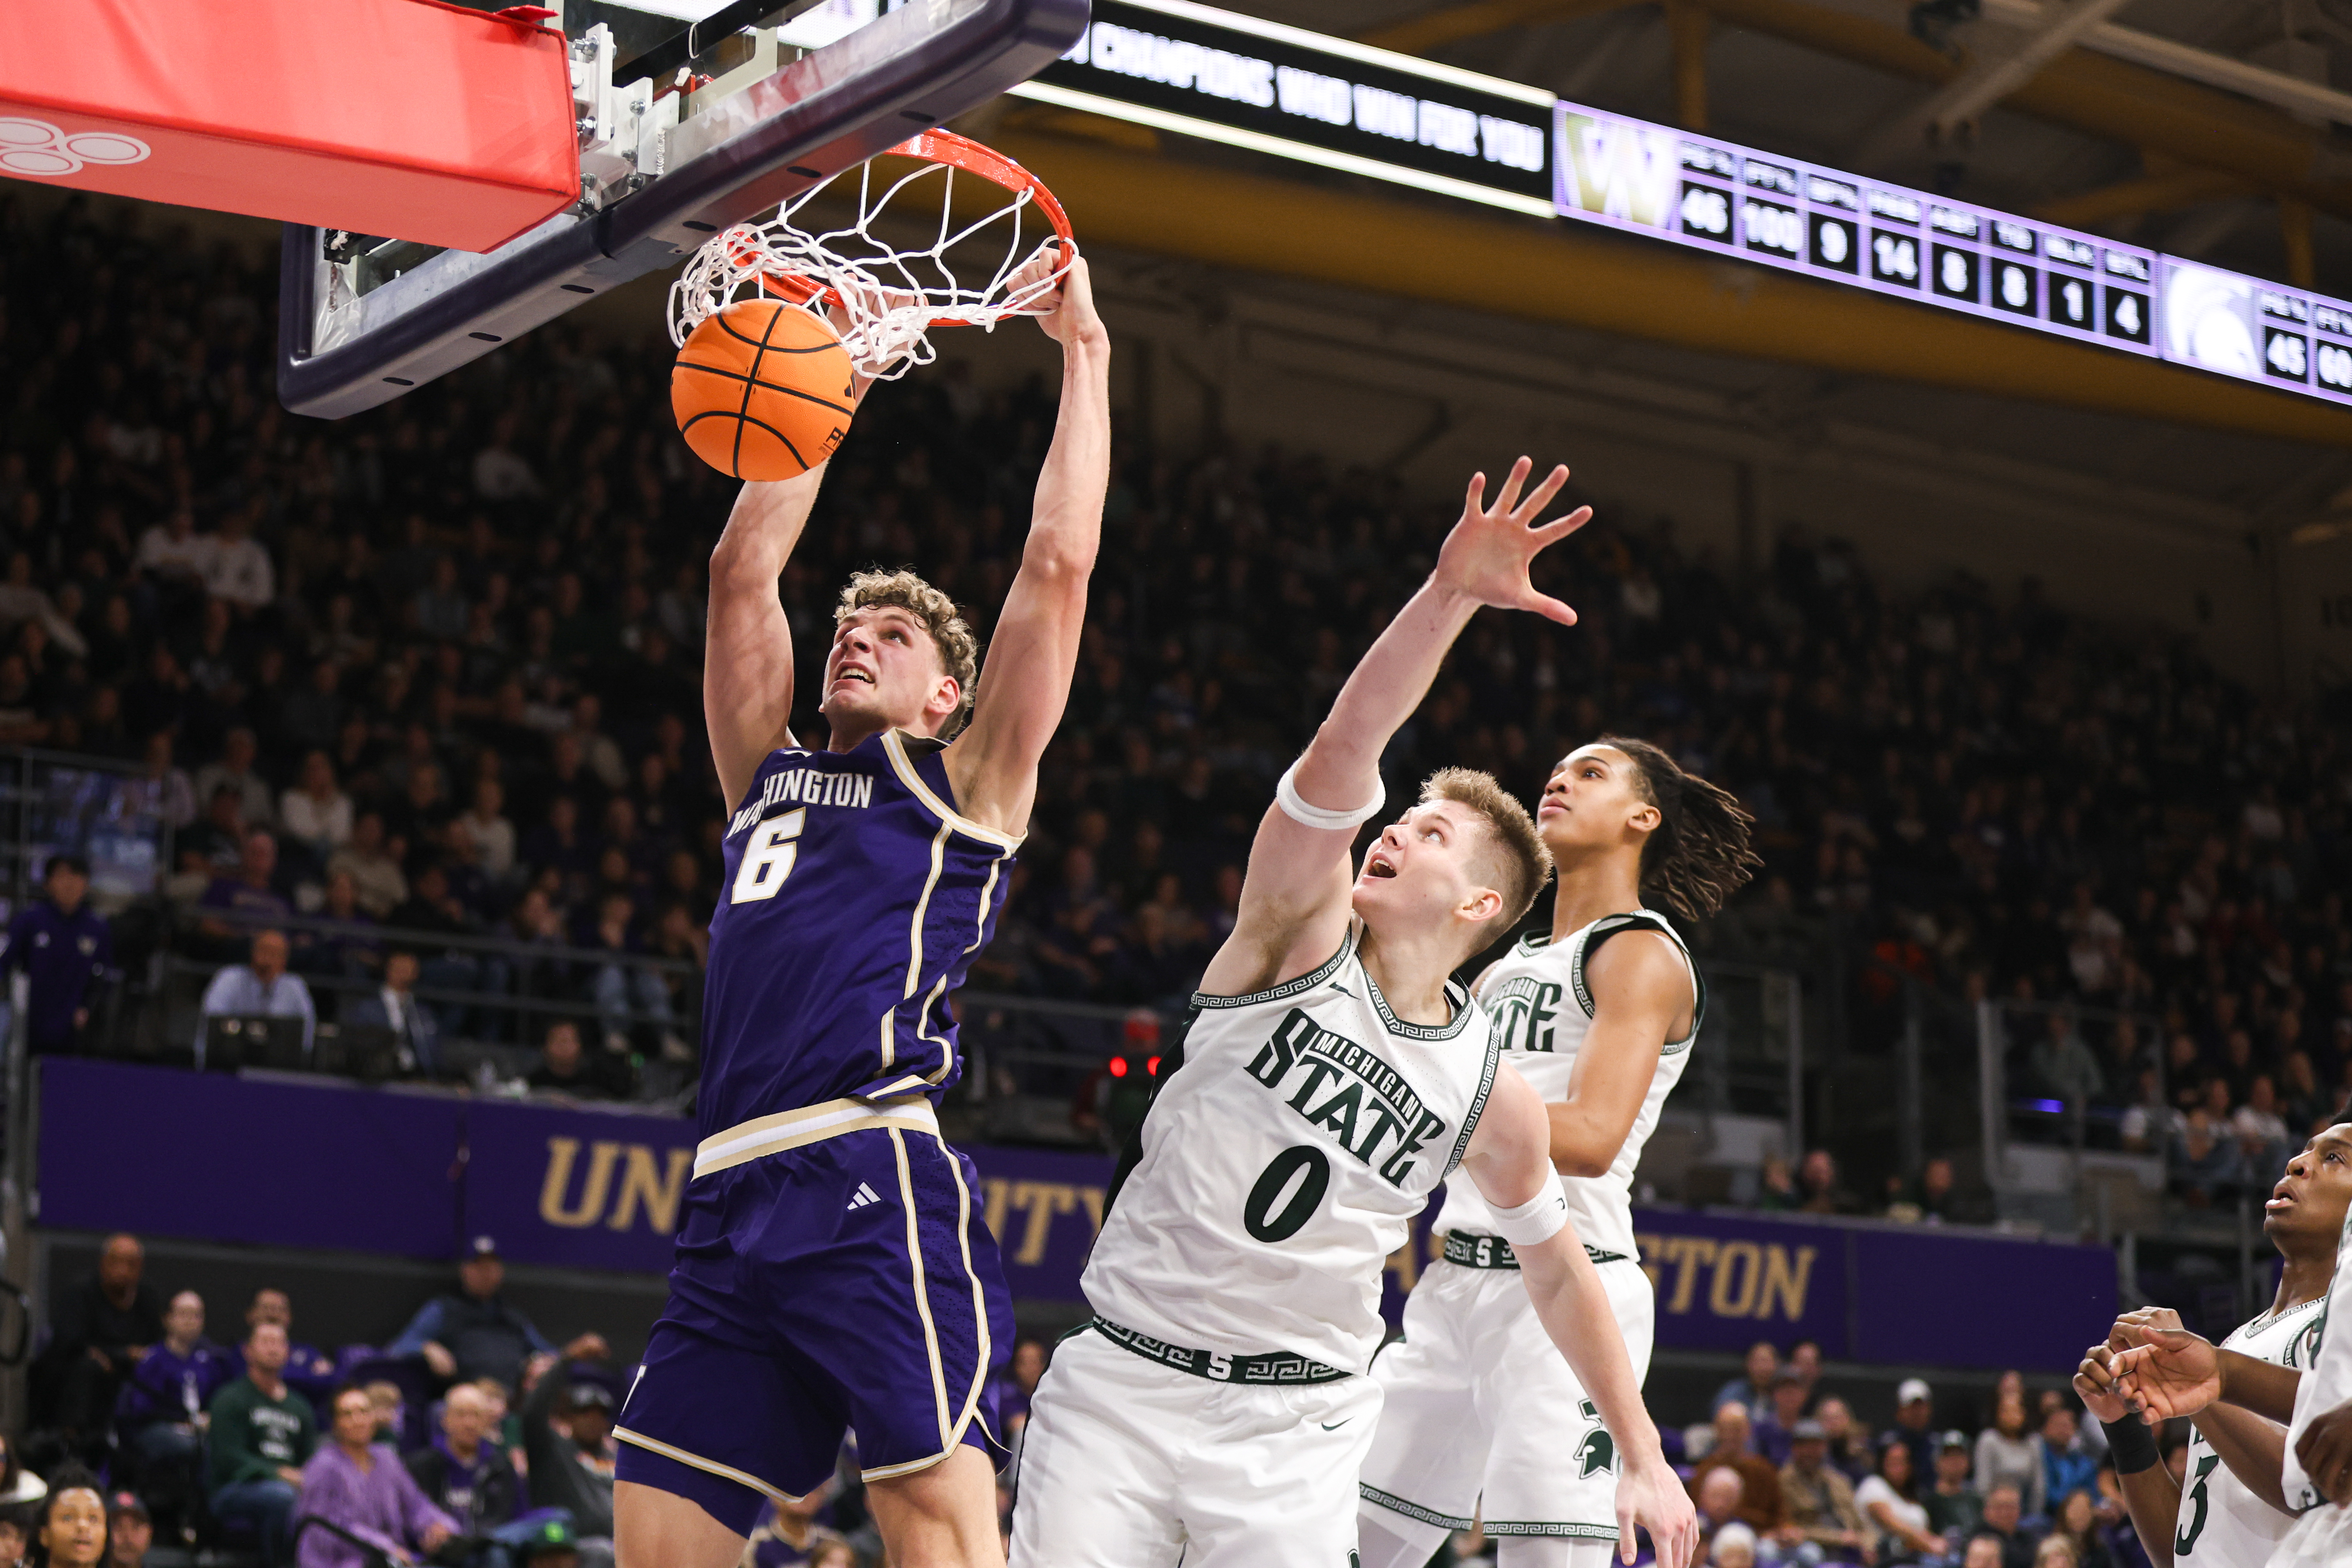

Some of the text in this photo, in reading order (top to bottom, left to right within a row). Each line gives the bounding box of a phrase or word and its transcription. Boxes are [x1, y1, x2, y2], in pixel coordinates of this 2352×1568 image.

[1091, 21, 1275, 107] CHAMPIONS
[1277, 66, 1352, 125] WHO
[1353, 84, 1417, 141] WIN
[1418, 100, 1478, 156] FOR
[1479, 115, 1544, 172] YOU
[1874, 234, 1918, 280] 14
[2064, 282, 2084, 321] 1
[2115, 295, 2141, 334] 4
[731, 806, 806, 904] 6
[1243, 1008, 1446, 1189] STATE
[1315, 1031, 1420, 1123] MICHIGAN
[1244, 1145, 1330, 1242] 0
[1476, 1238, 1493, 1267] S
[2175, 1455, 2219, 1556] 3
